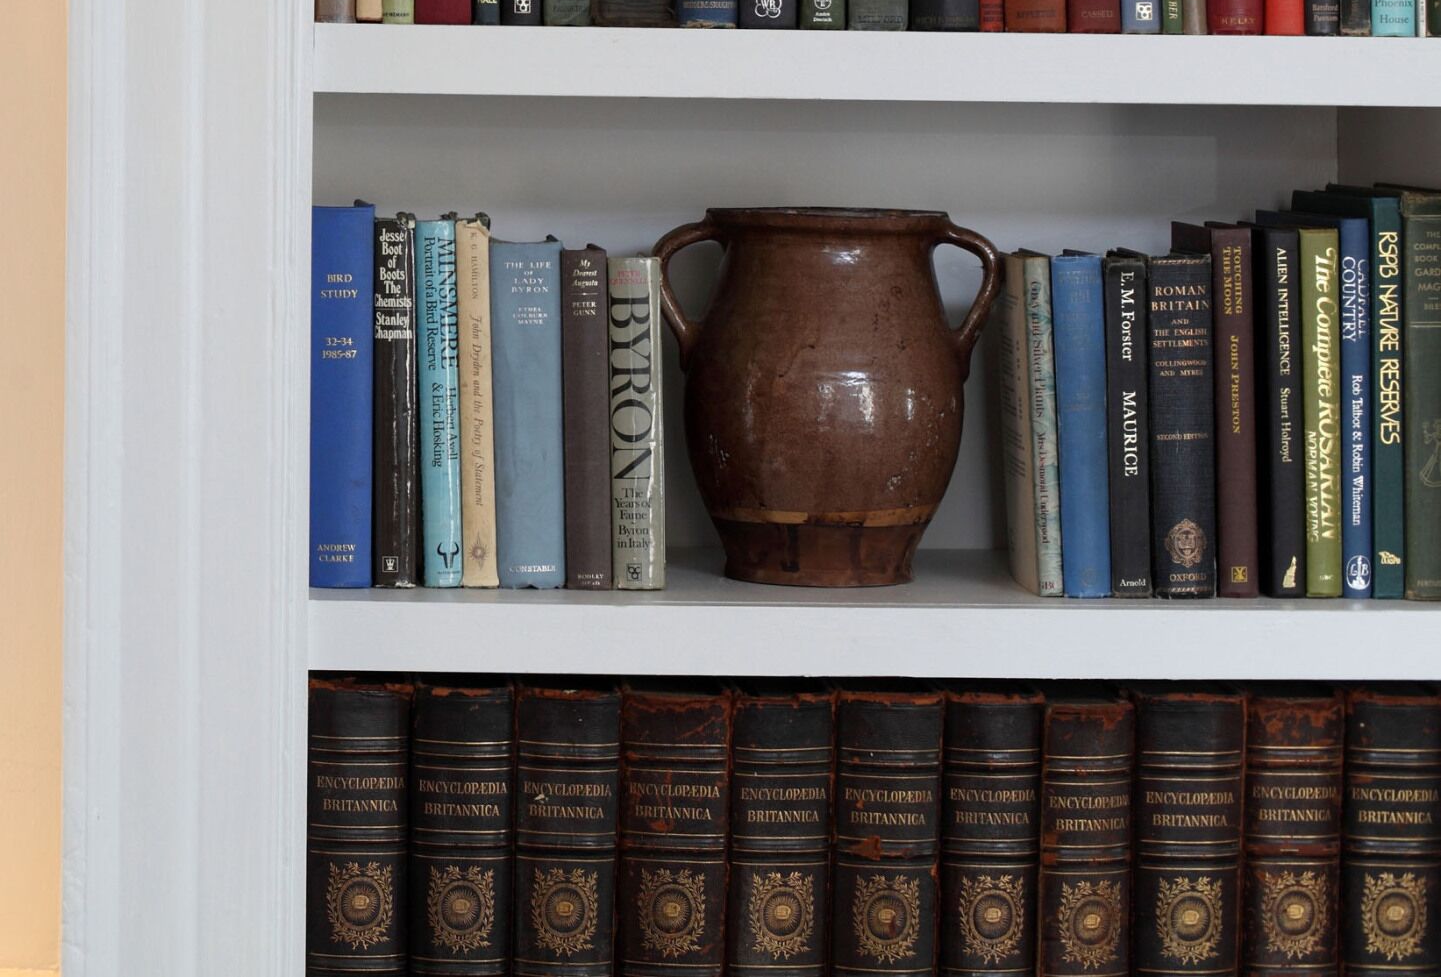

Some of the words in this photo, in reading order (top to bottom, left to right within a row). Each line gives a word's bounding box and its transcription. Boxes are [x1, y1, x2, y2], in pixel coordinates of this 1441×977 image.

[1380, 14, 1409, 24] House
[379, 228, 404, 242] Jesse
[382, 242, 402, 255] Boot
[1378, 231, 1398, 278] RSPB
[387, 256, 397, 269] of
[424, 236, 435, 278] Portrait
[1223, 246, 1232, 274] THE
[1276, 247, 1288, 283] ALIEN
[1315, 247, 1337, 292] The
[327, 274, 352, 283] BIRD
[379, 268, 405, 281] Boots
[1234, 246, 1242, 314] TOUCHING
[384, 281, 401, 294] The
[426, 280, 437, 291] of
[573, 279, 598, 288] Augusta
[320, 290, 358, 298] STUDY
[1155, 285, 1206, 297] ROMAN
[1223, 277, 1232, 315] MOON
[375, 294, 412, 308] Chemists
[437, 237, 459, 369] MINSMERE
[1151, 300, 1209, 311] BRITAIN
[1342, 256, 1356, 343] COUNTRY
[426, 300, 438, 324] Bird
[1379, 284, 1399, 352] NATURE
[376, 313, 409, 327] Stanley
[471, 315, 482, 339] John
[375, 328, 412, 342] Chapman
[1121, 311, 1135, 362] Forster
[1277, 288, 1290, 375] INTELLIGENCE
[326, 338, 352, 347] 32-34
[427, 327, 438, 371] Reserve
[1152, 339, 1208, 348] SETTLEMENTS
[1312, 296, 1337, 398] Complete
[322, 350, 357, 359] 1985-87
[471, 343, 482, 375] Dryden
[1231, 335, 1239, 369] JOHN
[432, 382, 443, 393] &
[473, 377, 482, 397] and
[610, 292, 653, 480] BYRON
[1352, 374, 1363, 395] Rob
[432, 396, 443, 417] Eric
[474, 399, 482, 414] the
[1231, 373, 1240, 433] PRESTON
[1280, 387, 1291, 418] Stuart
[1379, 358, 1401, 445] RESERVES
[1352, 399, 1363, 428] Talbot
[472, 418, 484, 446] Poetry
[1122, 391, 1138, 477] MAURICE
[1352, 431, 1363, 441] &
[432, 421, 444, 468] Hosking
[1280, 422, 1293, 463] Holroyd
[472, 447, 484, 458] of
[1352, 444, 1363, 472] Robin
[474, 459, 484, 507] Statement
[621, 488, 643, 498] The
[615, 499, 640, 508] Years
[1352, 475, 1364, 526] Whiteman
[620, 510, 647, 520] Fame
[618, 525, 649, 539] Byron
[317, 544, 356, 552] ANDREW
[617, 539, 627, 548] in
[629, 538, 650, 551] Italy
[1119, 578, 1146, 587] Arnold
[1169, 574, 1206, 582] OXFORD
[317, 775, 404, 790] ENCYCLOPÆDIA
[1146, 792, 1234, 804] ENCYCLOPÆDIA
[323, 799, 398, 812] BRITANNICA
[424, 803, 500, 817] BRITANNICA
[747, 810, 819, 823] BRITANNICA
[1152, 814, 1228, 827] BRITANNICA
[1359, 810, 1432, 824] BRITANNICA
